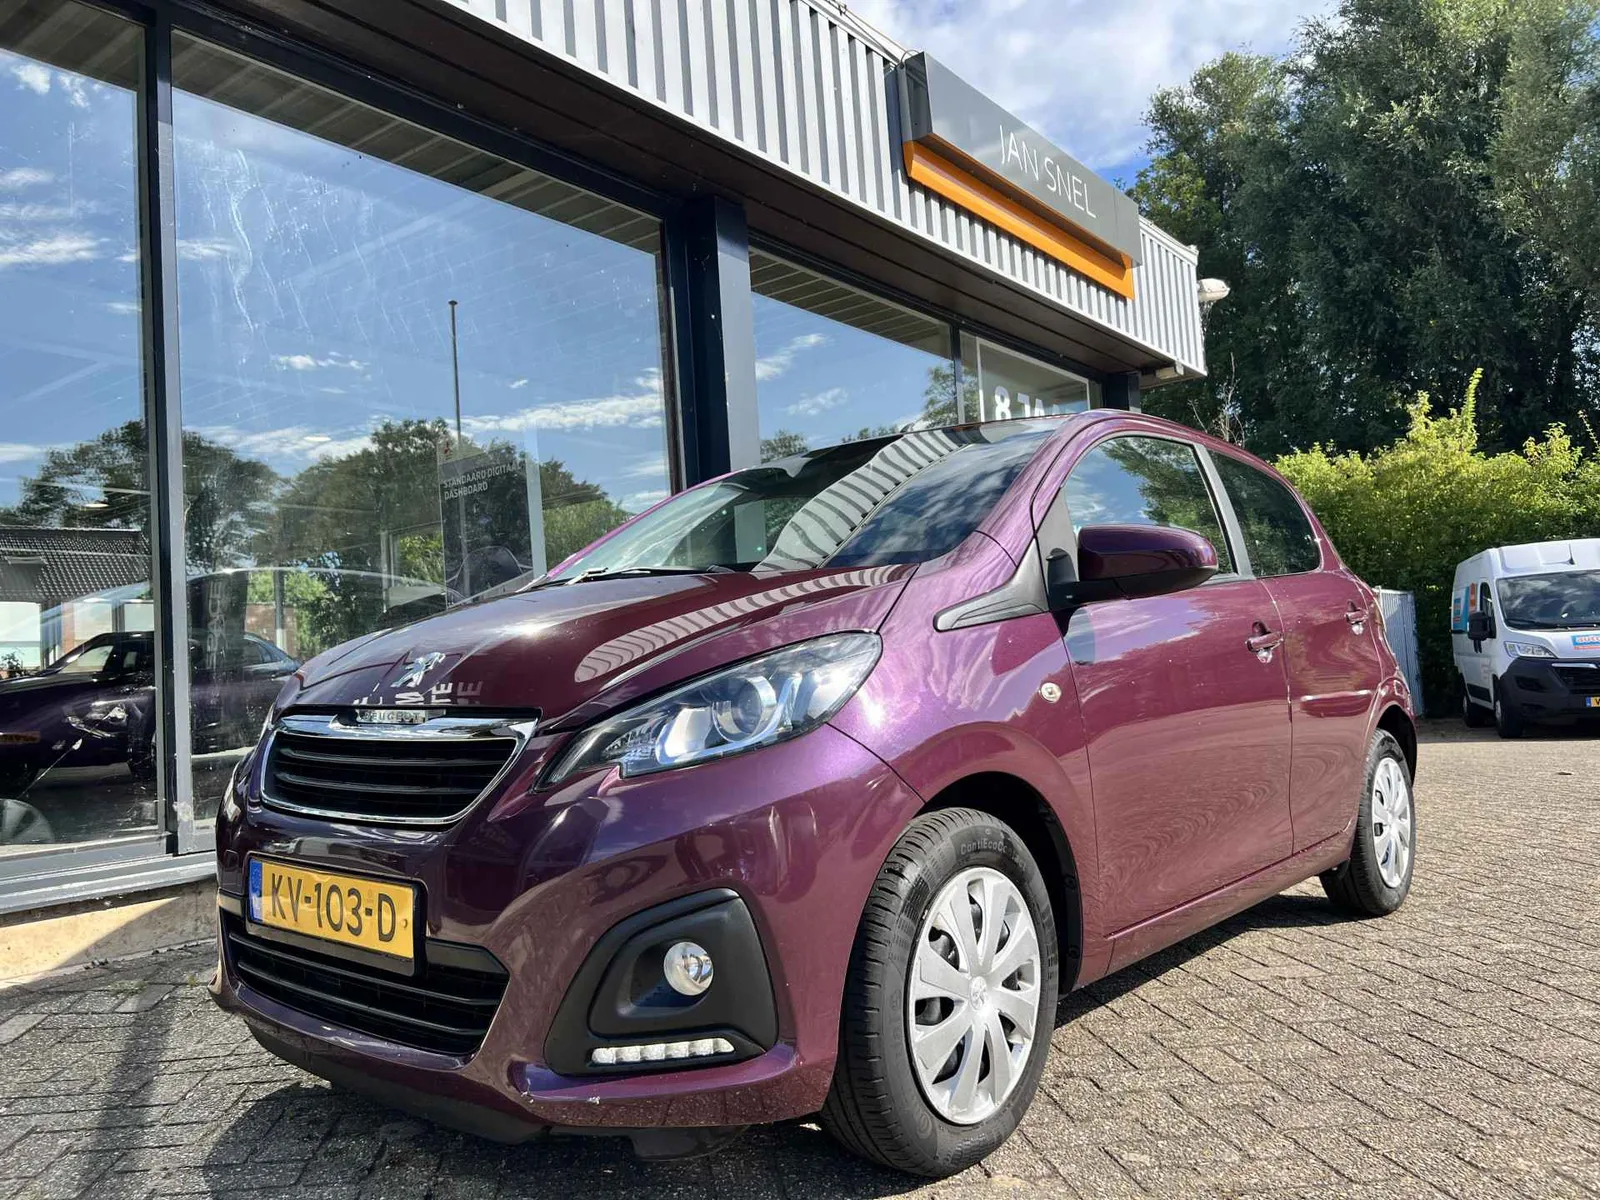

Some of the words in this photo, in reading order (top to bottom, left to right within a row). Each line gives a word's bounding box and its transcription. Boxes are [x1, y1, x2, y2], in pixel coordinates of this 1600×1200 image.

[999, 124, 1039, 181] JAN
[1044, 156, 1097, 219] SNEL
[443, 471, 486, 489] STANDAARD
[444, 481, 488, 501] DASHBOARD
[363, 711, 421, 723] PEUGEOT
[271, 872, 396, 943] KV-103-D
